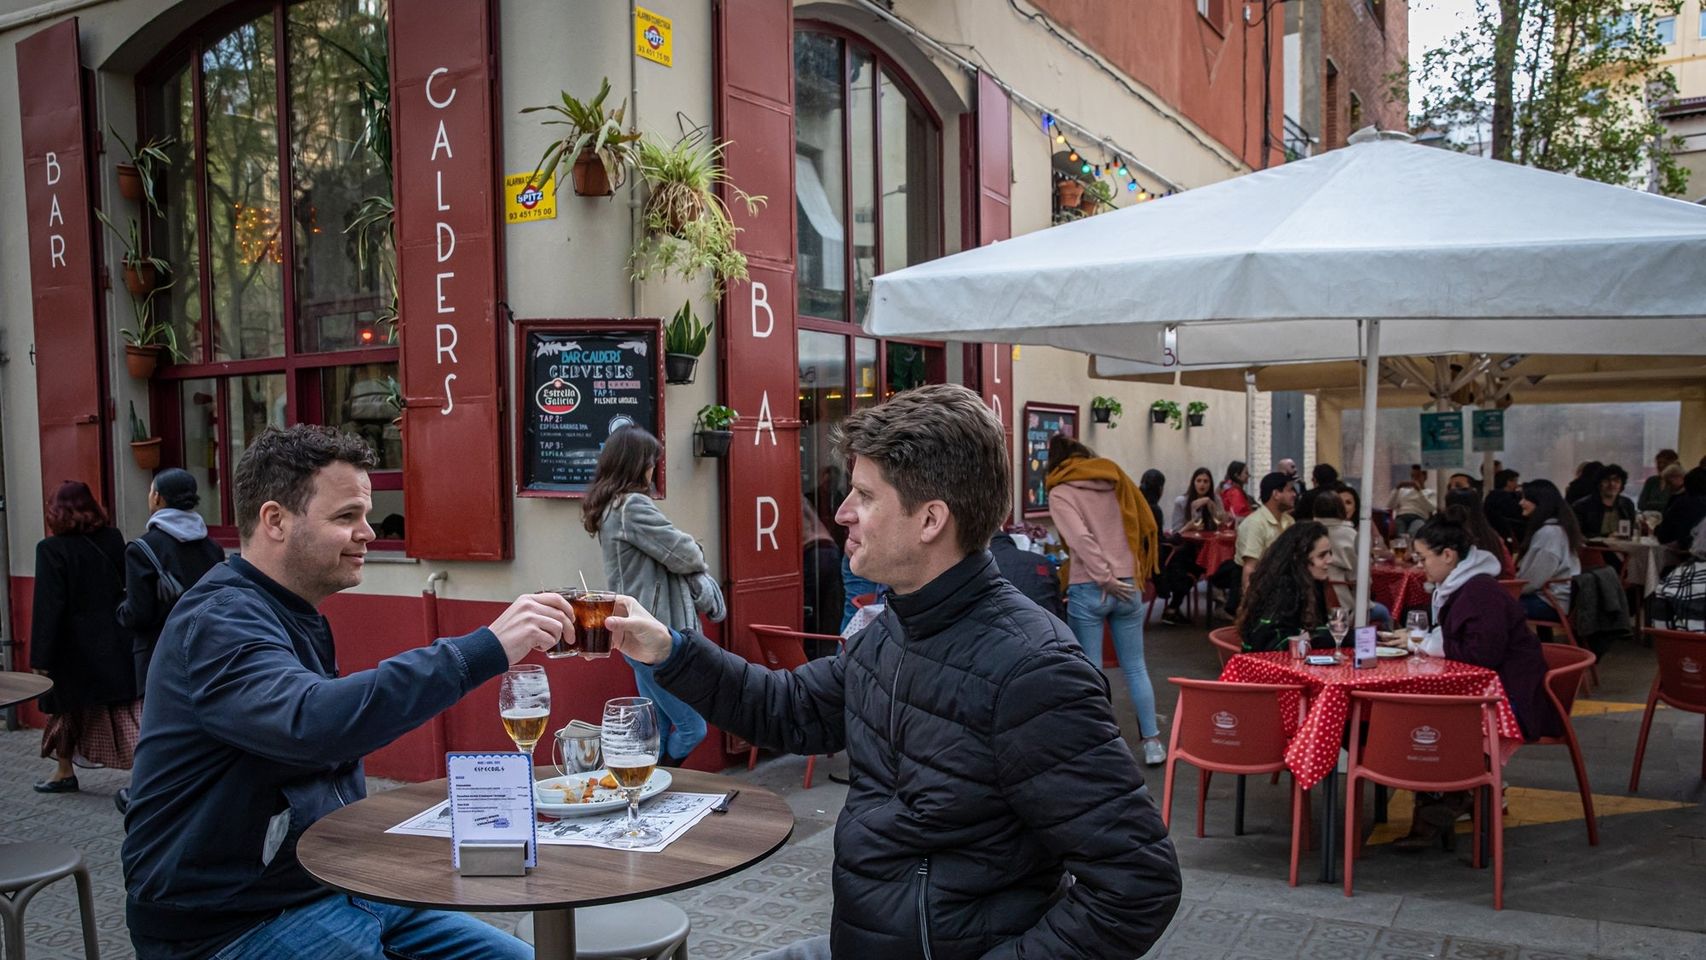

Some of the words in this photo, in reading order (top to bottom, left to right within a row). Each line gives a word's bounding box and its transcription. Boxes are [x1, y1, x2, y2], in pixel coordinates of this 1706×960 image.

[518, 191, 542, 202] SPITZ
[46, 151, 66, 269] BAR
[509, 212, 517, 220] 93
[425, 67, 458, 416] CALDERS
[562, 351, 580, 362] BAR
[582, 350, 621, 362] CALDERS
[549, 365, 634, 379] CERVESES
[543, 388, 576, 398] Estrella
[544, 397, 575, 406] Galicia
[594, 397, 618, 405] PILSNER
[751, 281, 780, 552] BAR
[540, 441, 554, 449] TAP
